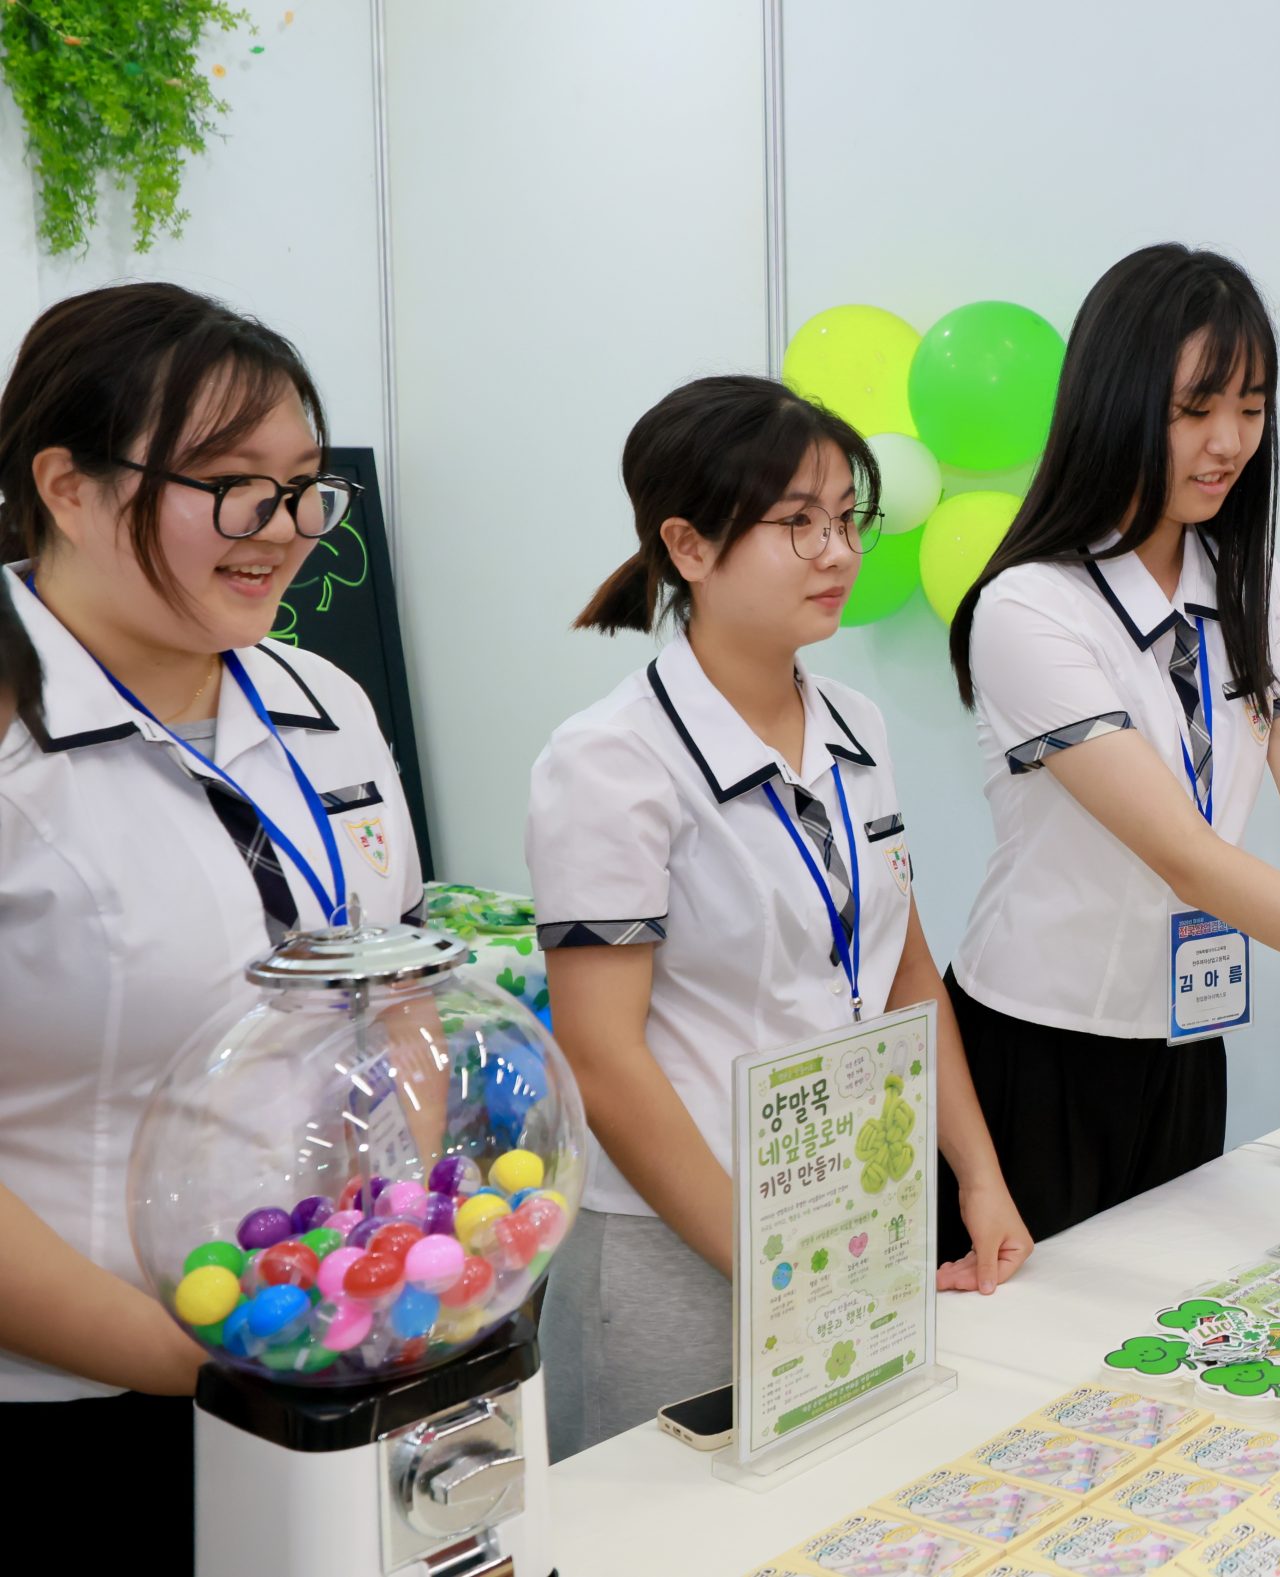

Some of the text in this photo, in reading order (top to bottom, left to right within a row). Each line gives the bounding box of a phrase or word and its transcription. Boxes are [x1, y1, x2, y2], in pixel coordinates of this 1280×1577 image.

[762, 1078, 830, 1133] 양말목
[758, 1111, 854, 1166] 네잎클로버
[760, 1153, 841, 1199] 키링 만들기
[816, 1318, 843, 1339] 행운과
